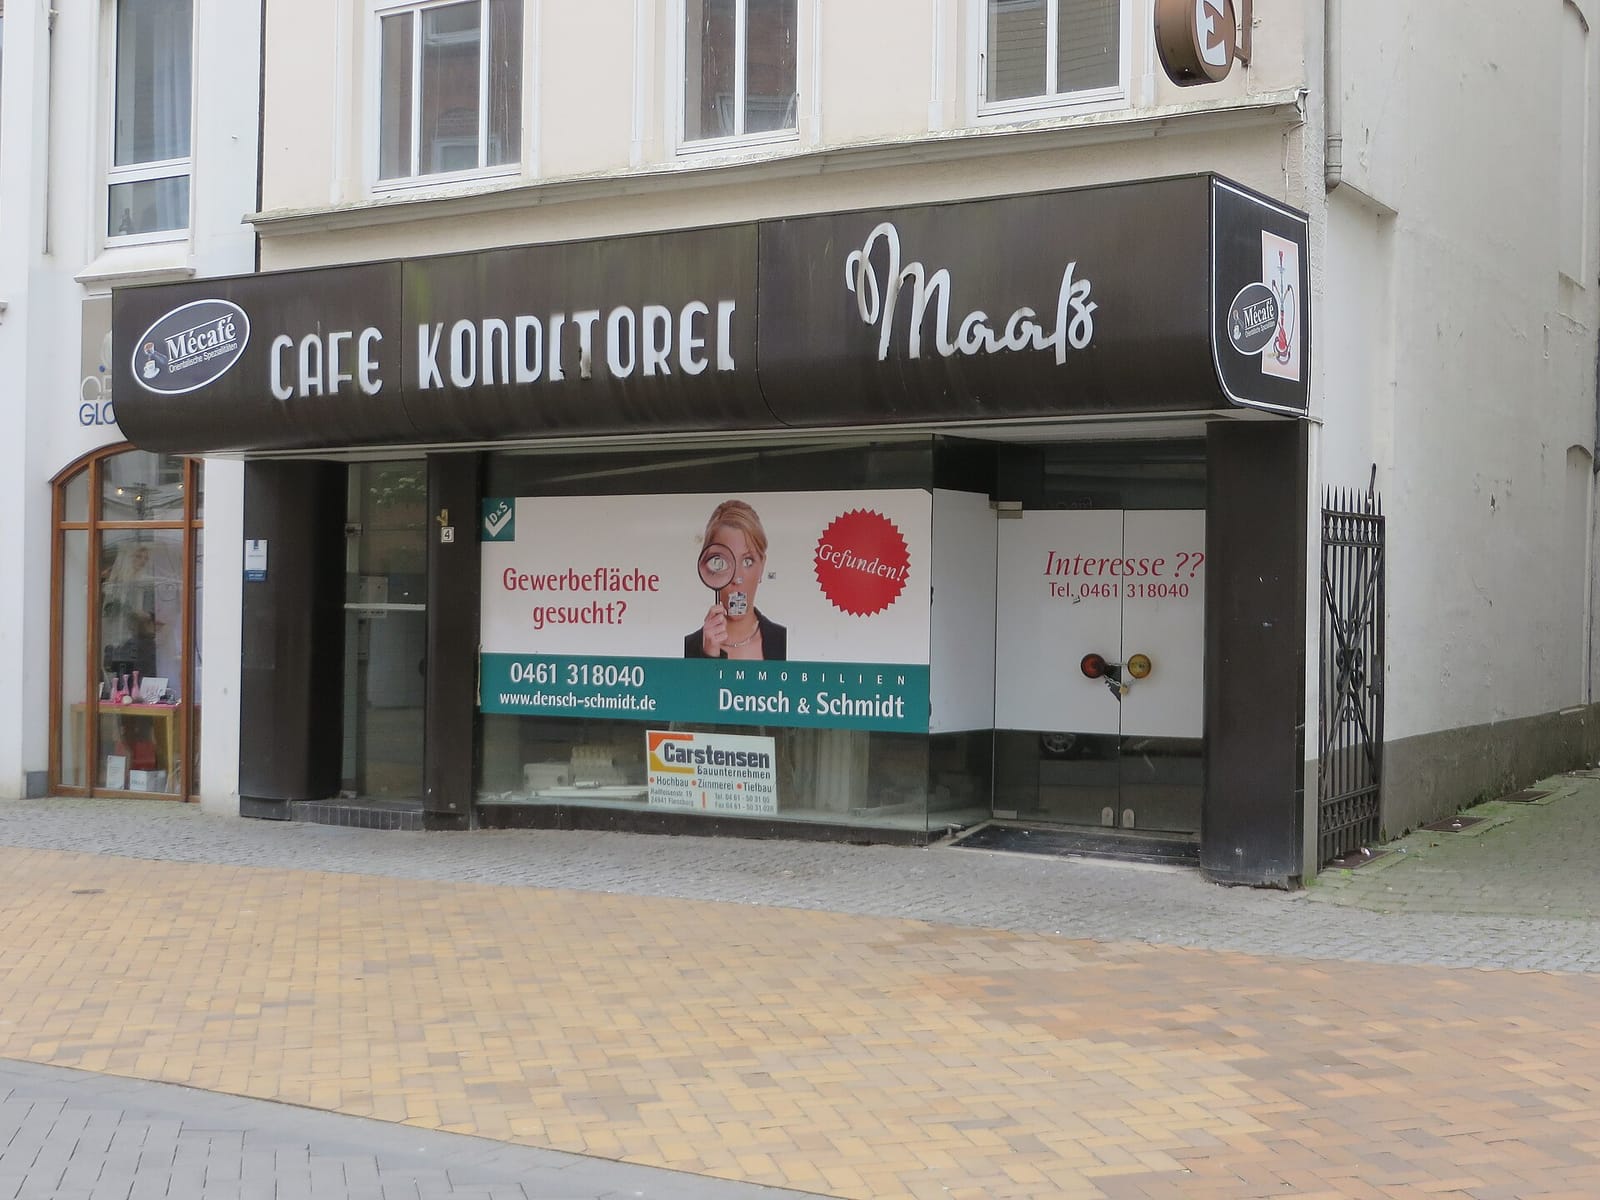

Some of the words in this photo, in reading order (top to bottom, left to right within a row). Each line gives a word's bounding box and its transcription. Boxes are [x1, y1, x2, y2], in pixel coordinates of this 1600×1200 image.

[1243, 299, 1275, 329] Mécafé
[166, 315, 237, 363] Mécafé
[271, 326, 383, 400] CAFE
[418, 300, 736, 390] KONDITOREI
[203, 342, 239, 362] Spezialitäten
[818, 544, 906, 582] Gefunden!
[1043, 550, 1166, 577] Interesse
[502, 567, 660, 592] Gewerbefläche
[1048, 582, 1075, 598] Tel.
[1080, 583, 1119, 598] 0461
[1126, 583, 1190, 598] 318040
[533, 600, 628, 631] gesucht?
[509, 662, 557, 685] 0461
[566, 663, 646, 687] 318040
[499, 690, 657, 711] www.densch-schmidt.de
[718, 688, 790, 714] Densch
[797, 697, 811, 715] &
[816, 691, 906, 719] Schmidt
[663, 741, 770, 769] Carstensen
[656, 775, 689, 787] Hochbau
[697, 765, 771, 780] Bauunternehmen
[697, 778, 734, 790] Zimmerei
[743, 781, 772, 793] Tiefbau
